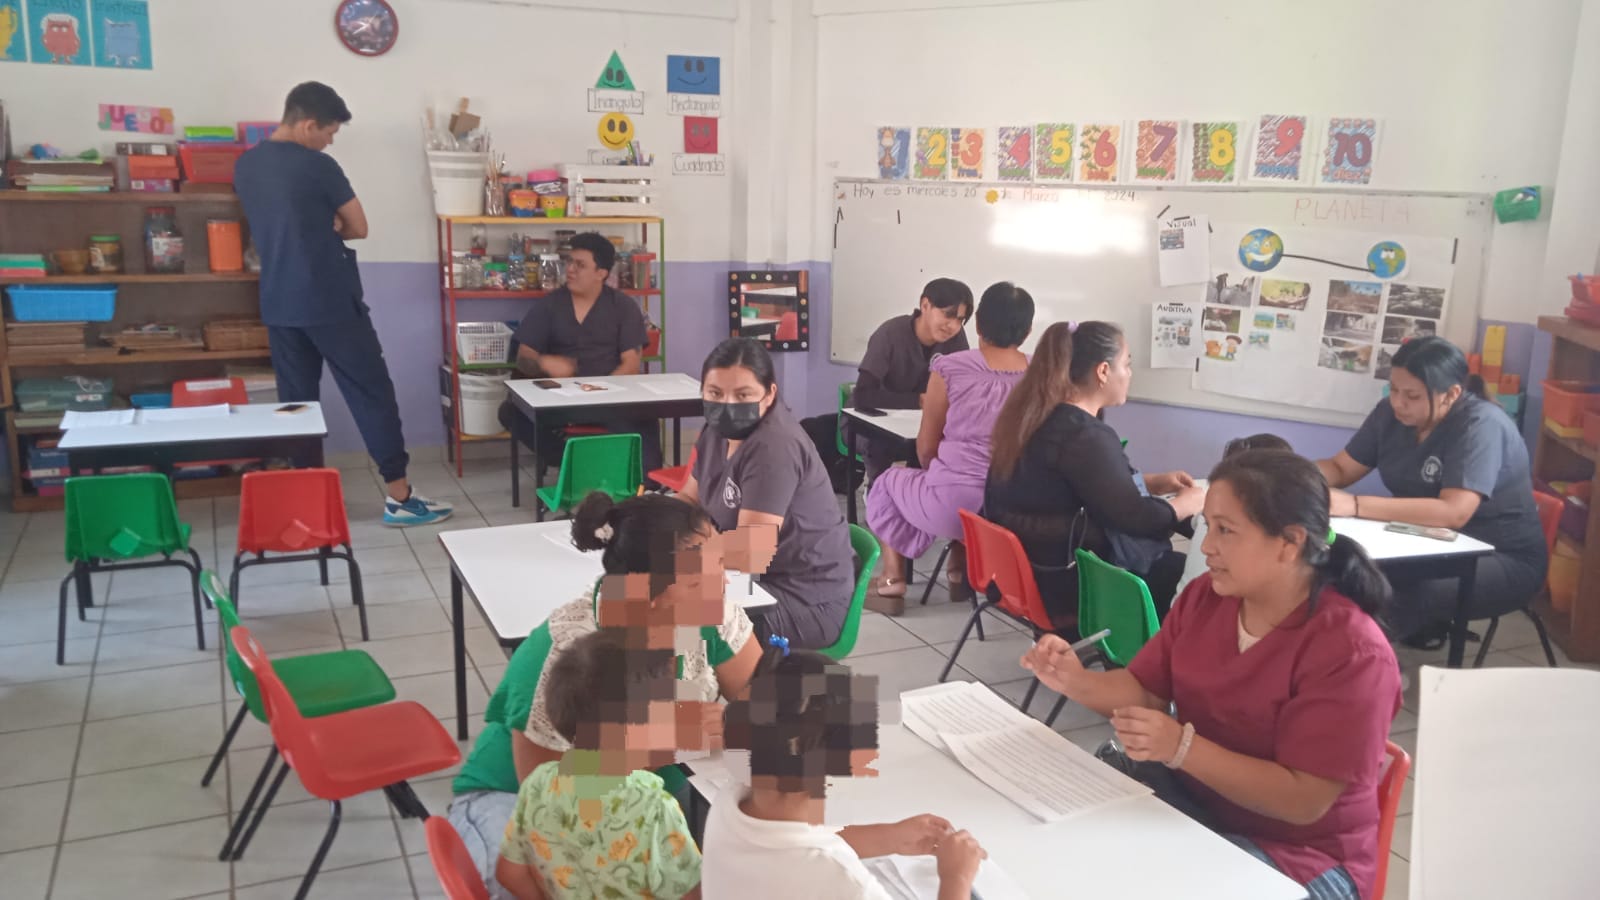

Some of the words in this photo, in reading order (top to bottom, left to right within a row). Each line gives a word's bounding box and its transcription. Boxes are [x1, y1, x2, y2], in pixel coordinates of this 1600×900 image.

[928, 133, 947, 165] 2
[960, 132, 984, 166] 3
[1007, 132, 1031, 168] 4
[1050, 129, 1073, 164] 5
[1093, 129, 1117, 168] 6
[1150, 125, 1178, 162] 7
[1209, 128, 1236, 167] 8
[1274, 117, 1305, 158] 9
[1332, 131, 1373, 168] 10
[853, 183, 875, 199] Hoy
[884, 187, 902, 196] es
[963, 186, 978, 198] 20
[1294, 197, 1409, 224] PLANETA
